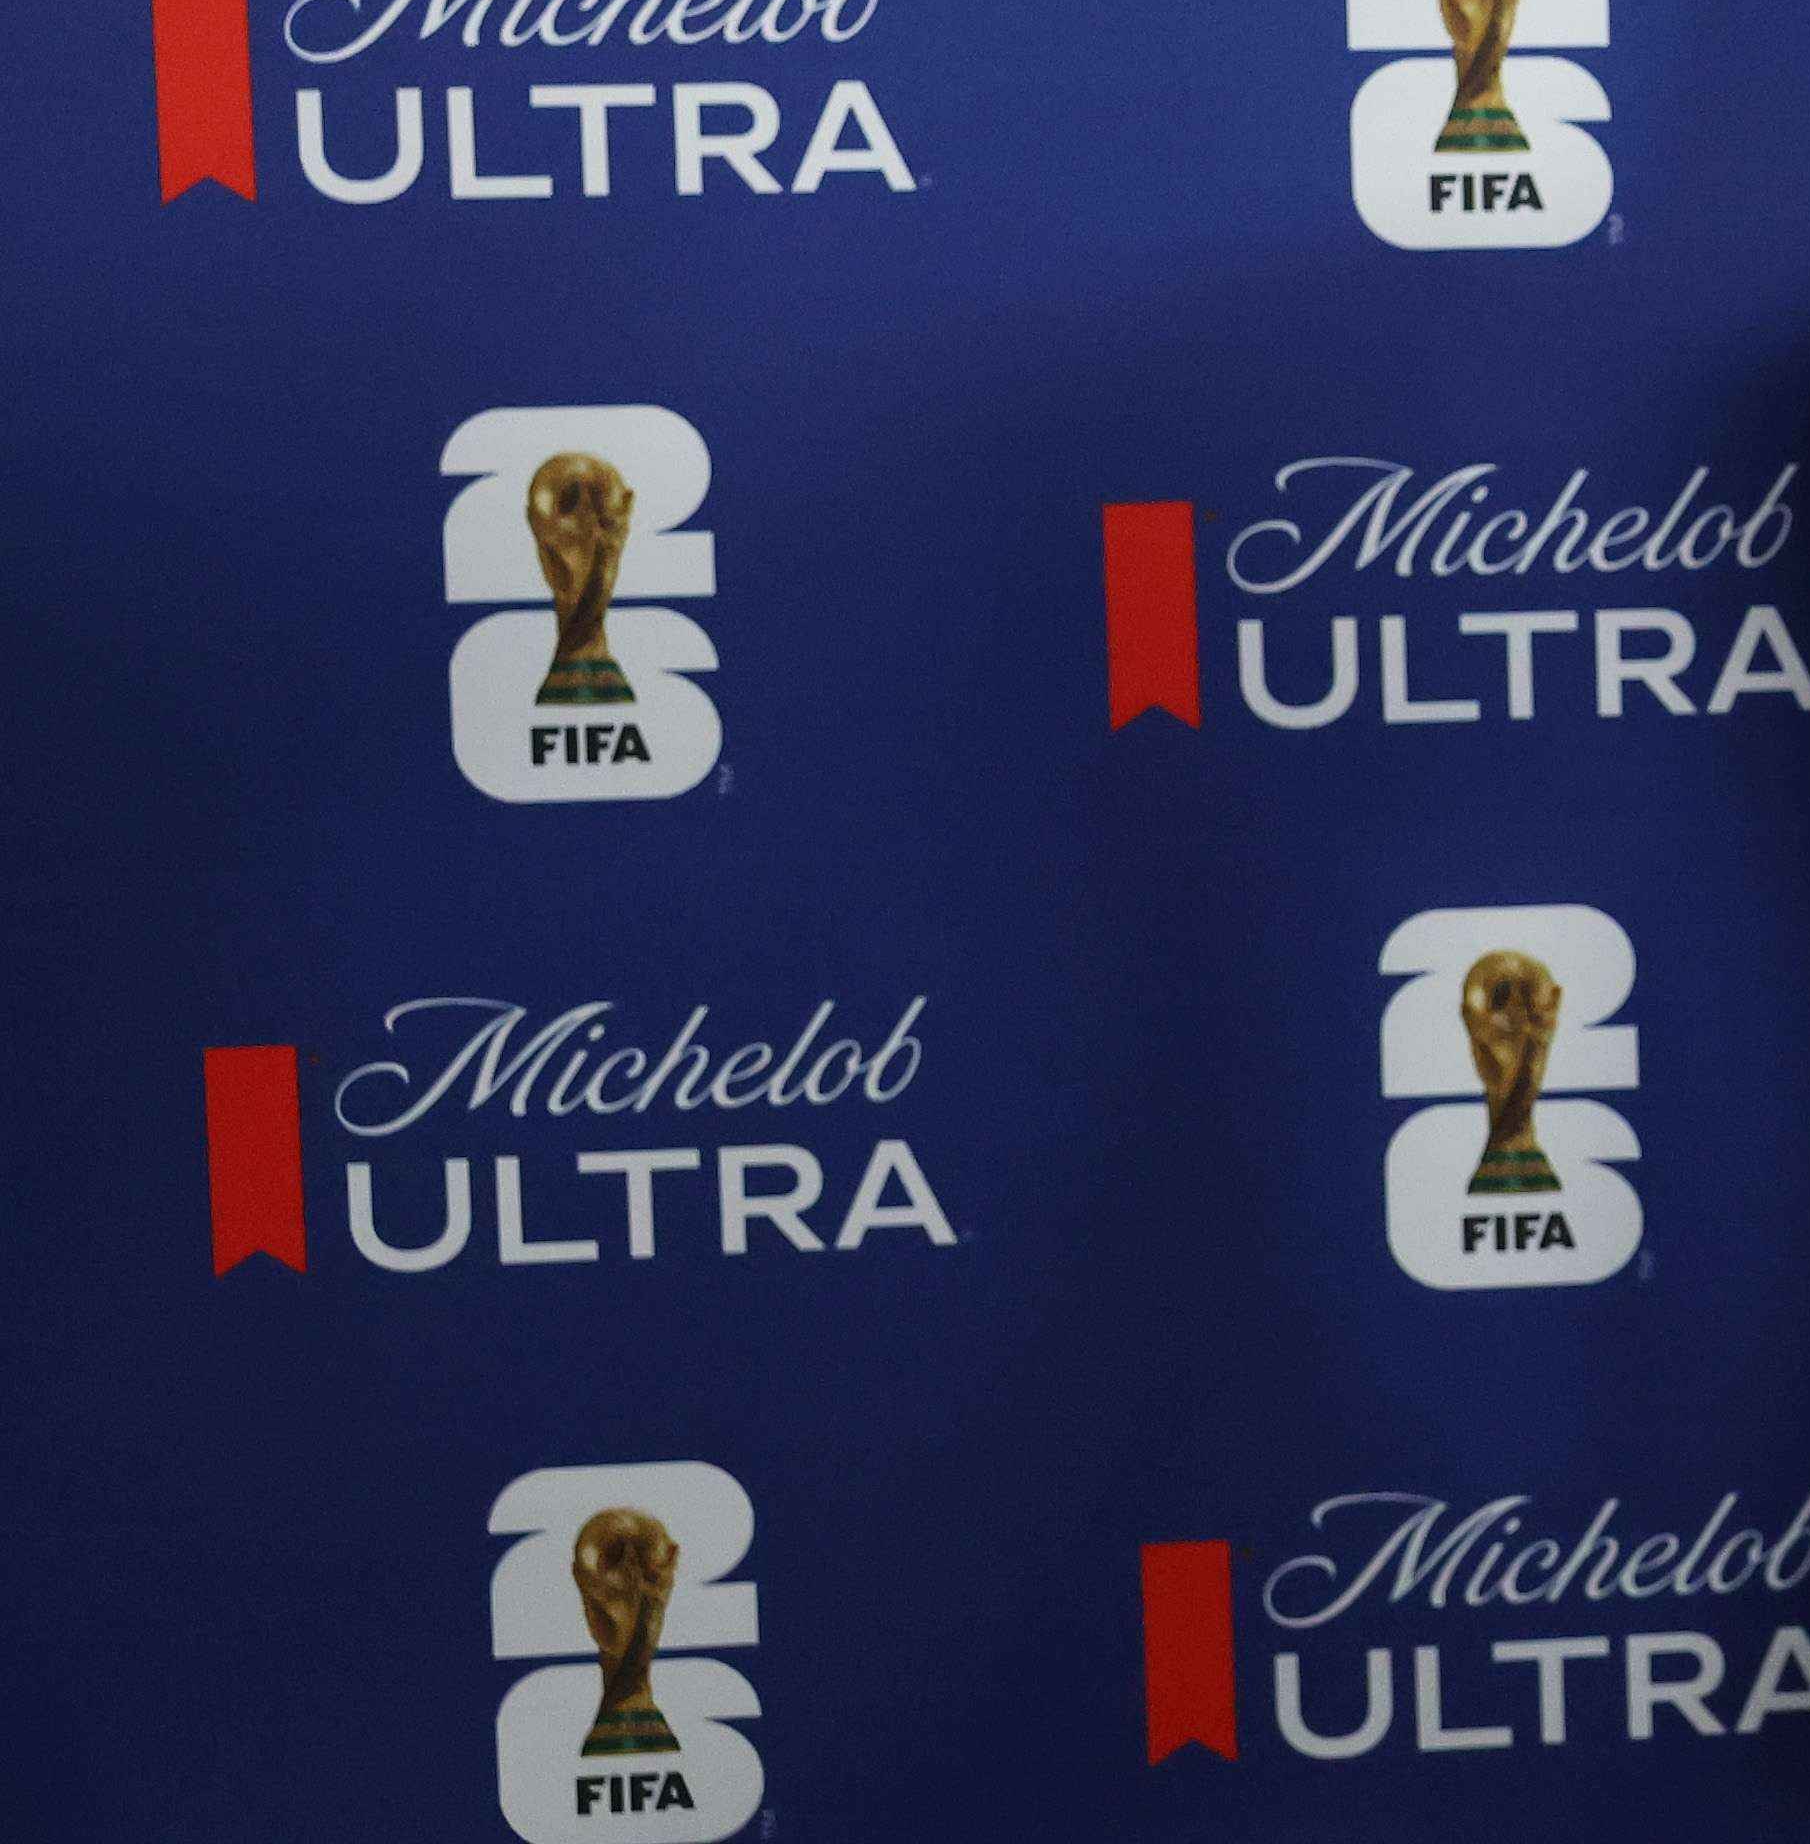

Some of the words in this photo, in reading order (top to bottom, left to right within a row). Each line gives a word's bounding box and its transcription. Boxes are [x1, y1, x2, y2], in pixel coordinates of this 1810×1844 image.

[296, 80, 916, 204] ULTRA
[1429, 173, 1544, 213] FIFA
[1227, 457, 1796, 593] Michelob
[529, 723, 653, 767] FIFA
[335, 996, 926, 1136] Michelob
[347, 1140, 957, 1272] ULTRA
[1462, 1211, 1576, 1254] FIFA
[575, 1771, 695, 1816] FIFA
